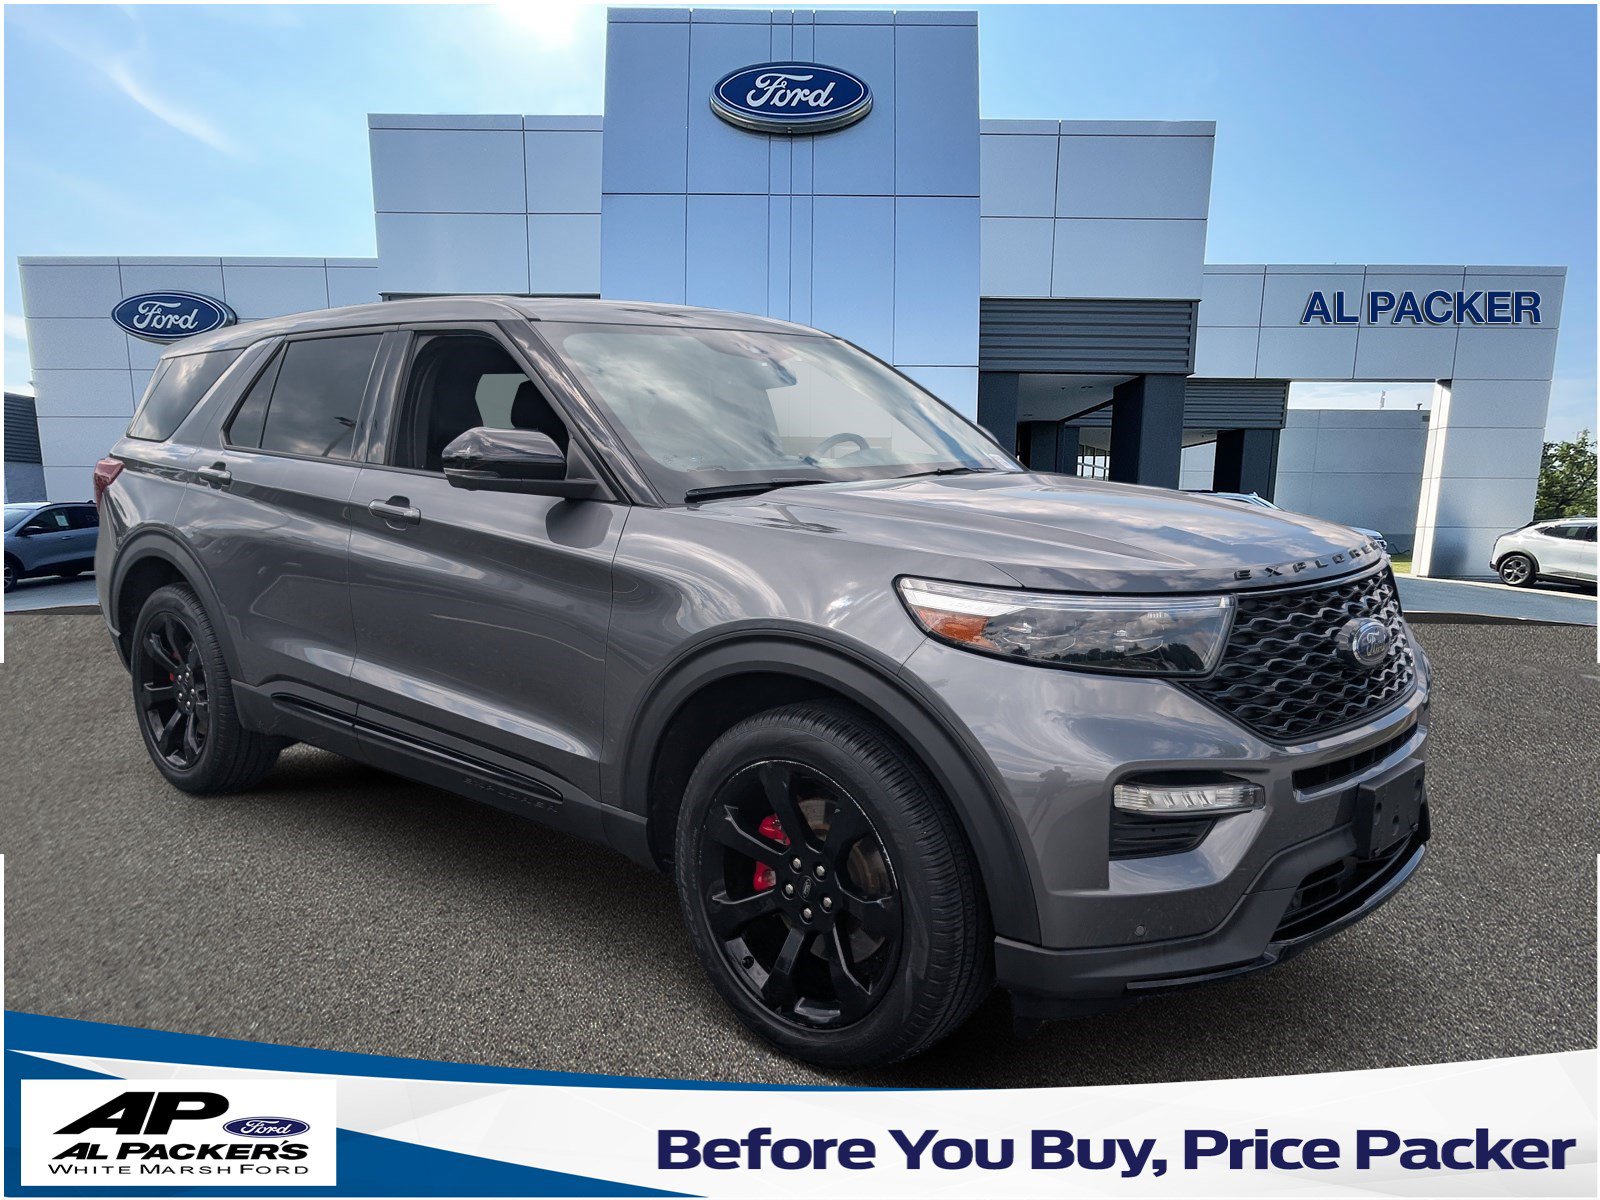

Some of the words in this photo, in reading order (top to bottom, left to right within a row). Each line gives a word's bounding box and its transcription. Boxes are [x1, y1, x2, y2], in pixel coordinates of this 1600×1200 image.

[746, 73, 836, 107] Ford
[133, 301, 199, 329] Ford
[1301, 290, 1359, 324] AL
[1368, 290, 1542, 324] PACKER
[1233, 541, 1380, 581] EXPLORER
